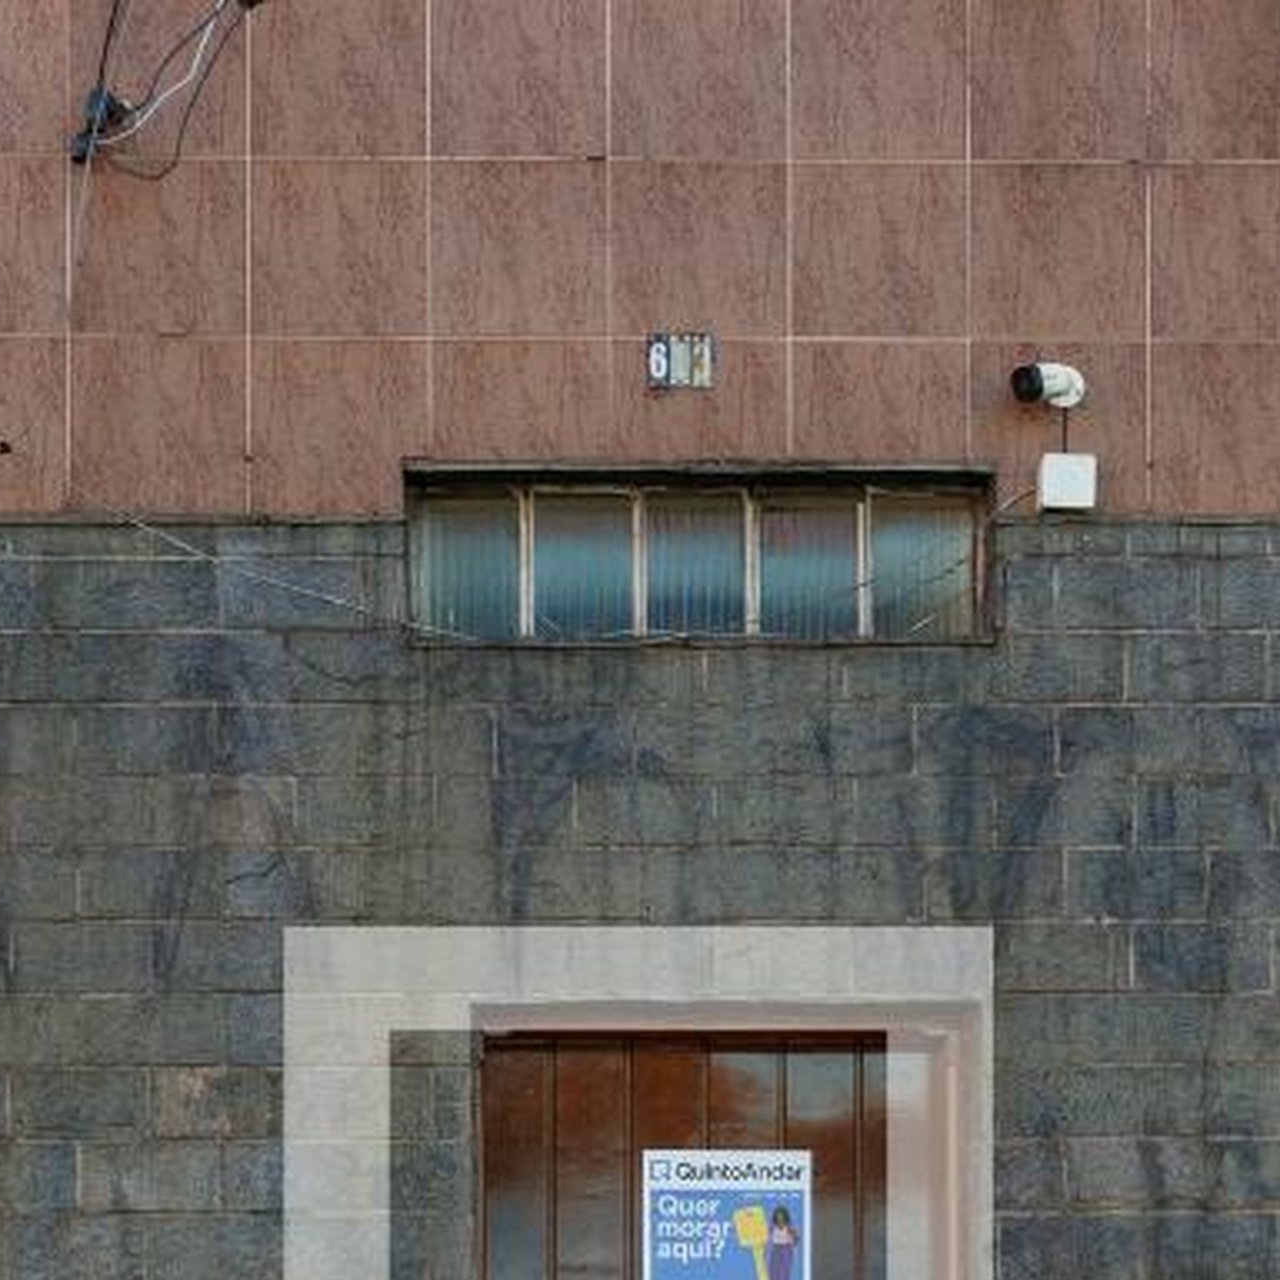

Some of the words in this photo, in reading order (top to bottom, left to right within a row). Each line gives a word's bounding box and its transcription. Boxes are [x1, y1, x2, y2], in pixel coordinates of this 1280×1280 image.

[675, 1162, 802, 1181] QuintoAndar
[658, 1194, 720, 1217] Quer
[657, 1219, 731, 1237] morar
[658, 1240, 725, 1264] aqui?
